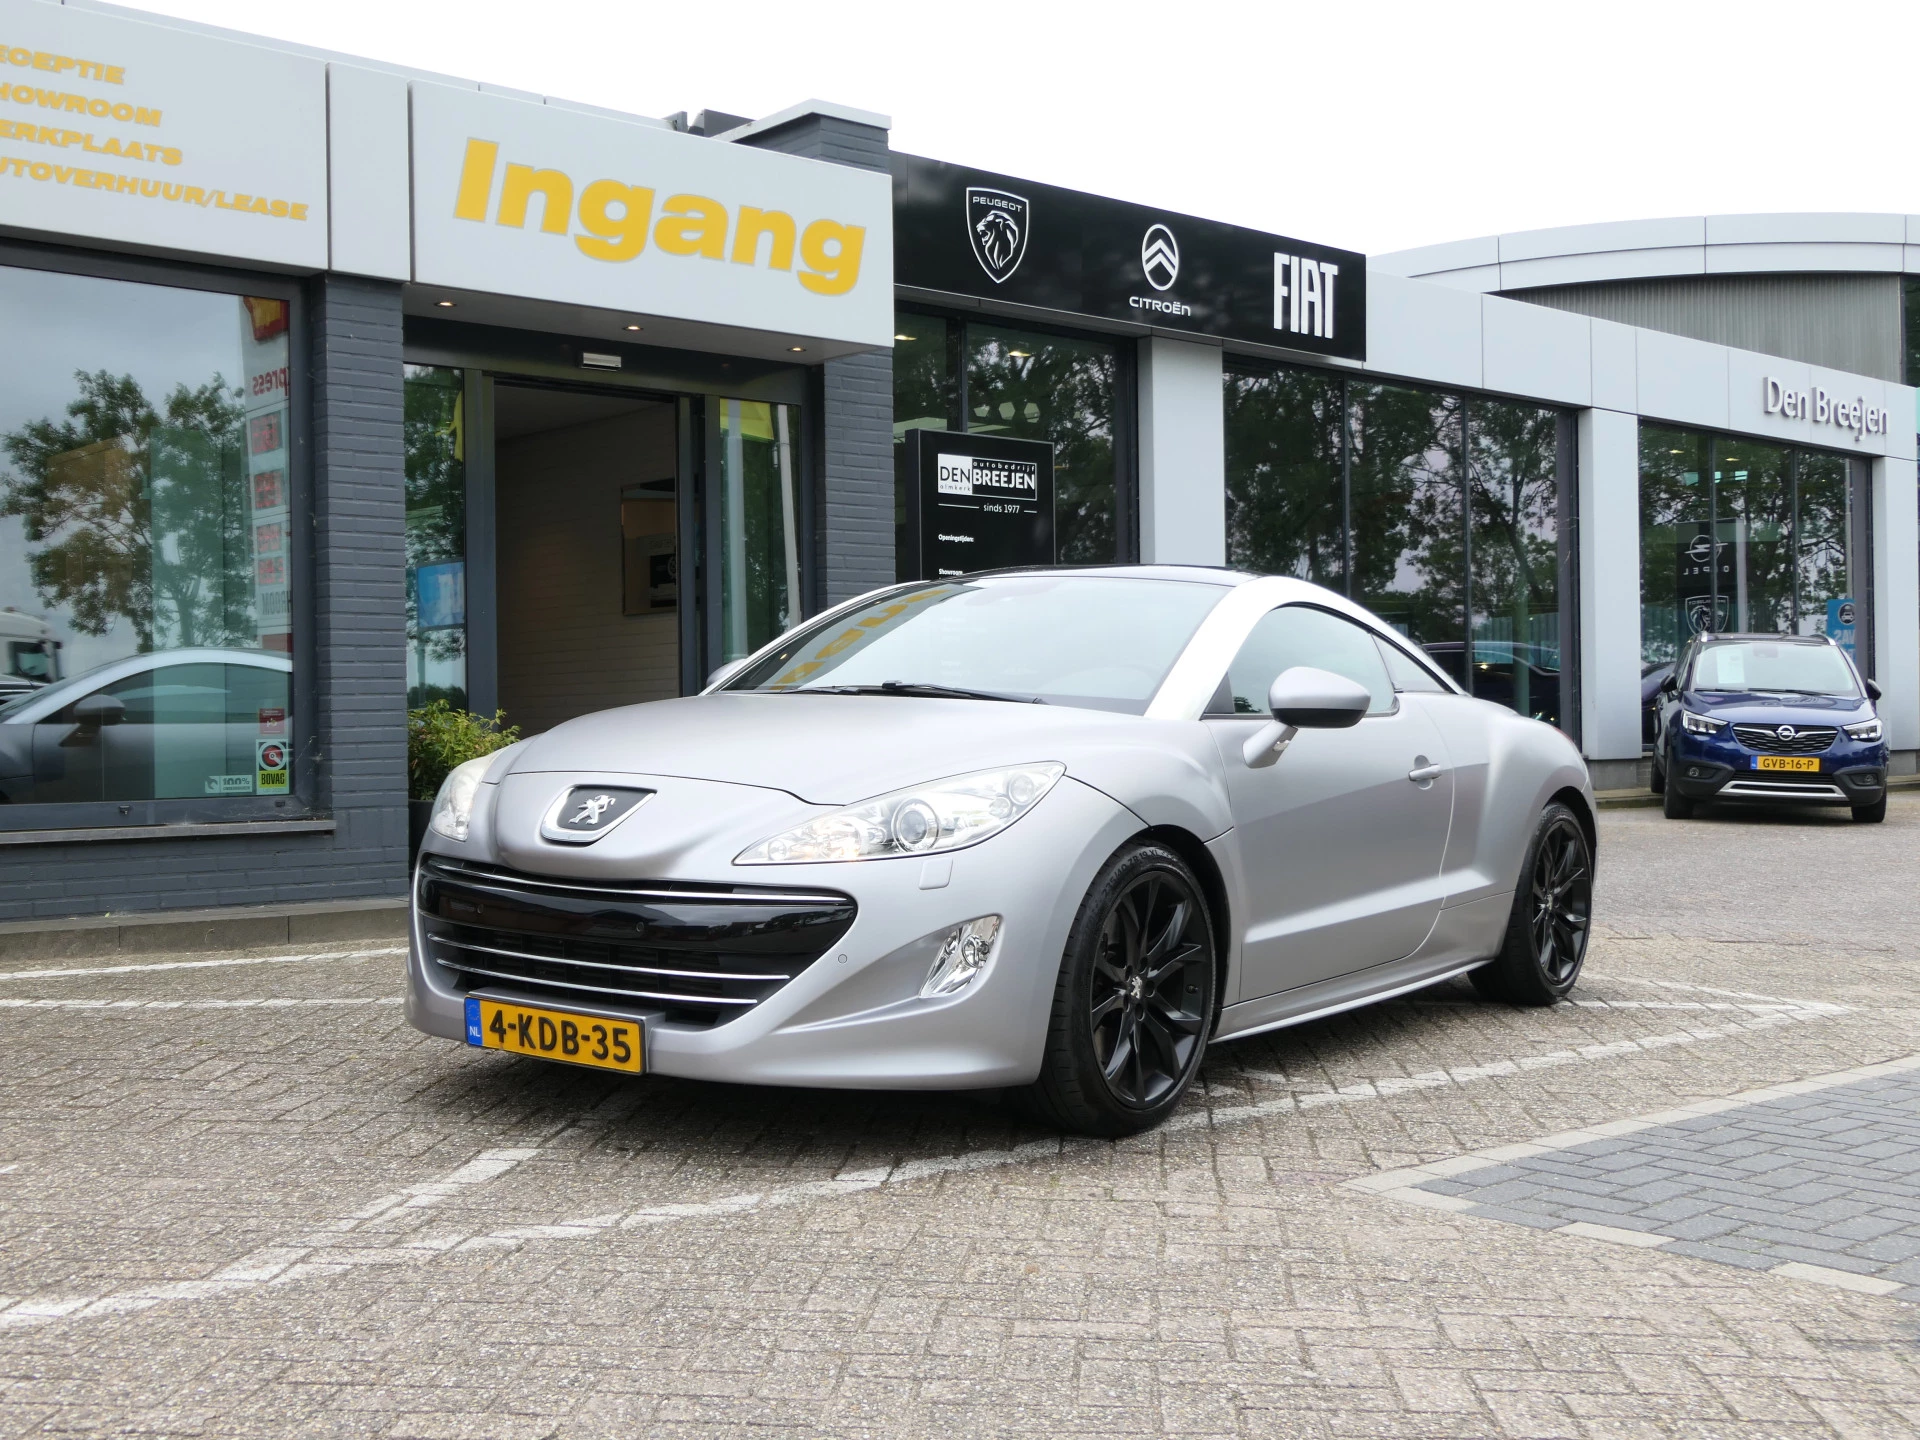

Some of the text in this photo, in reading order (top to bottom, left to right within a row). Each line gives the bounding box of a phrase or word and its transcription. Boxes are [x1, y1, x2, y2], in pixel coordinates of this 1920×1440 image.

[0, 118, 183, 166] ERKPLAATS
[453, 137, 867, 296] Ingang
[972, 196, 1023, 213] PEUGEOT
[1273, 252, 1339, 339] FIAT
[1763, 376, 1889, 441] Den Breejen
[940, 466, 1035, 490] DEN BREEJEN
[973, 461, 1035, 472] autobedrijf
[983, 503, 1020, 514] sinds 1977
[1763, 758, 1814, 770] GVB-16-P
[469, 1009, 632, 1063] NL 4-KDB-35
